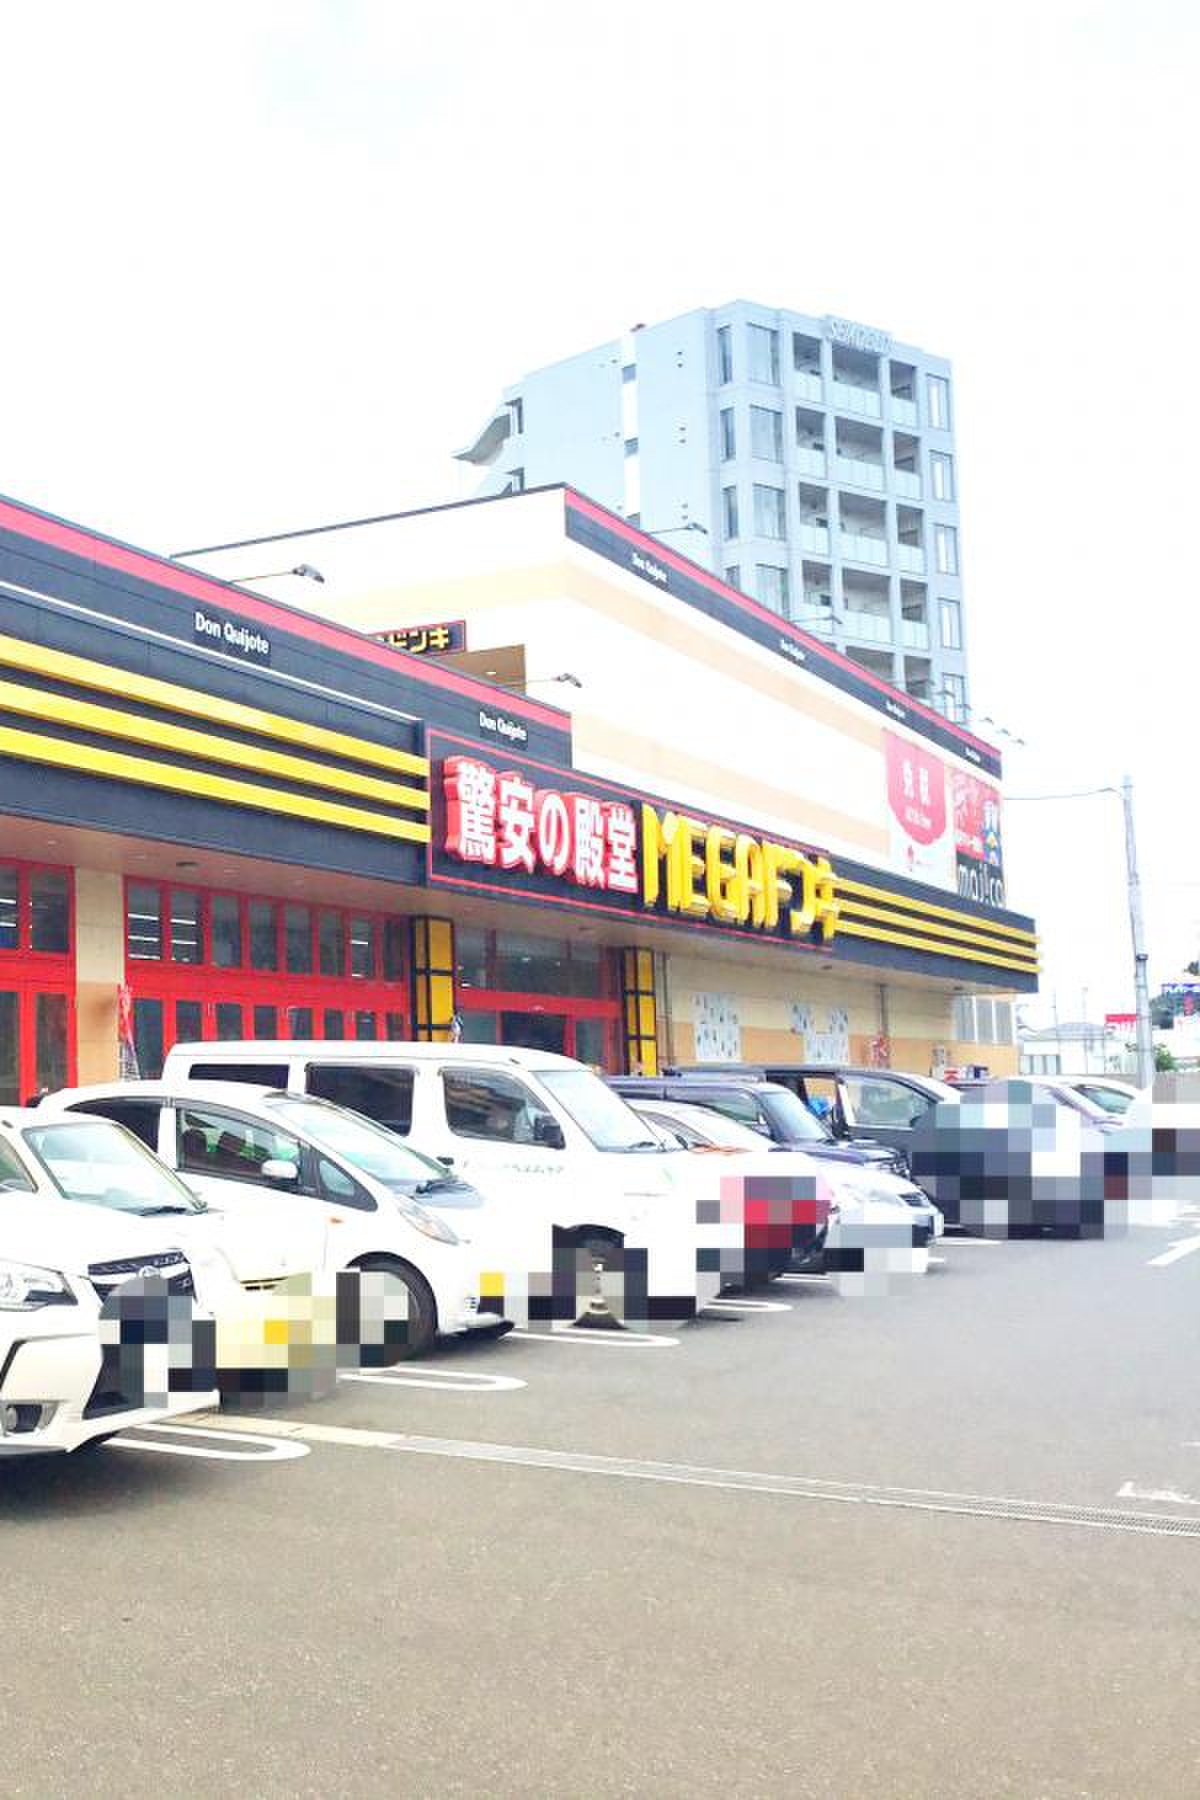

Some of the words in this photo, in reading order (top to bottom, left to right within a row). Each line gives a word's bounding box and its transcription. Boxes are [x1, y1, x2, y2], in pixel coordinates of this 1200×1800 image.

[195, 611, 221, 639] Don
[223, 621, 270, 654] Quijote
[444, 756, 639, 894] 驚安の殿堂
